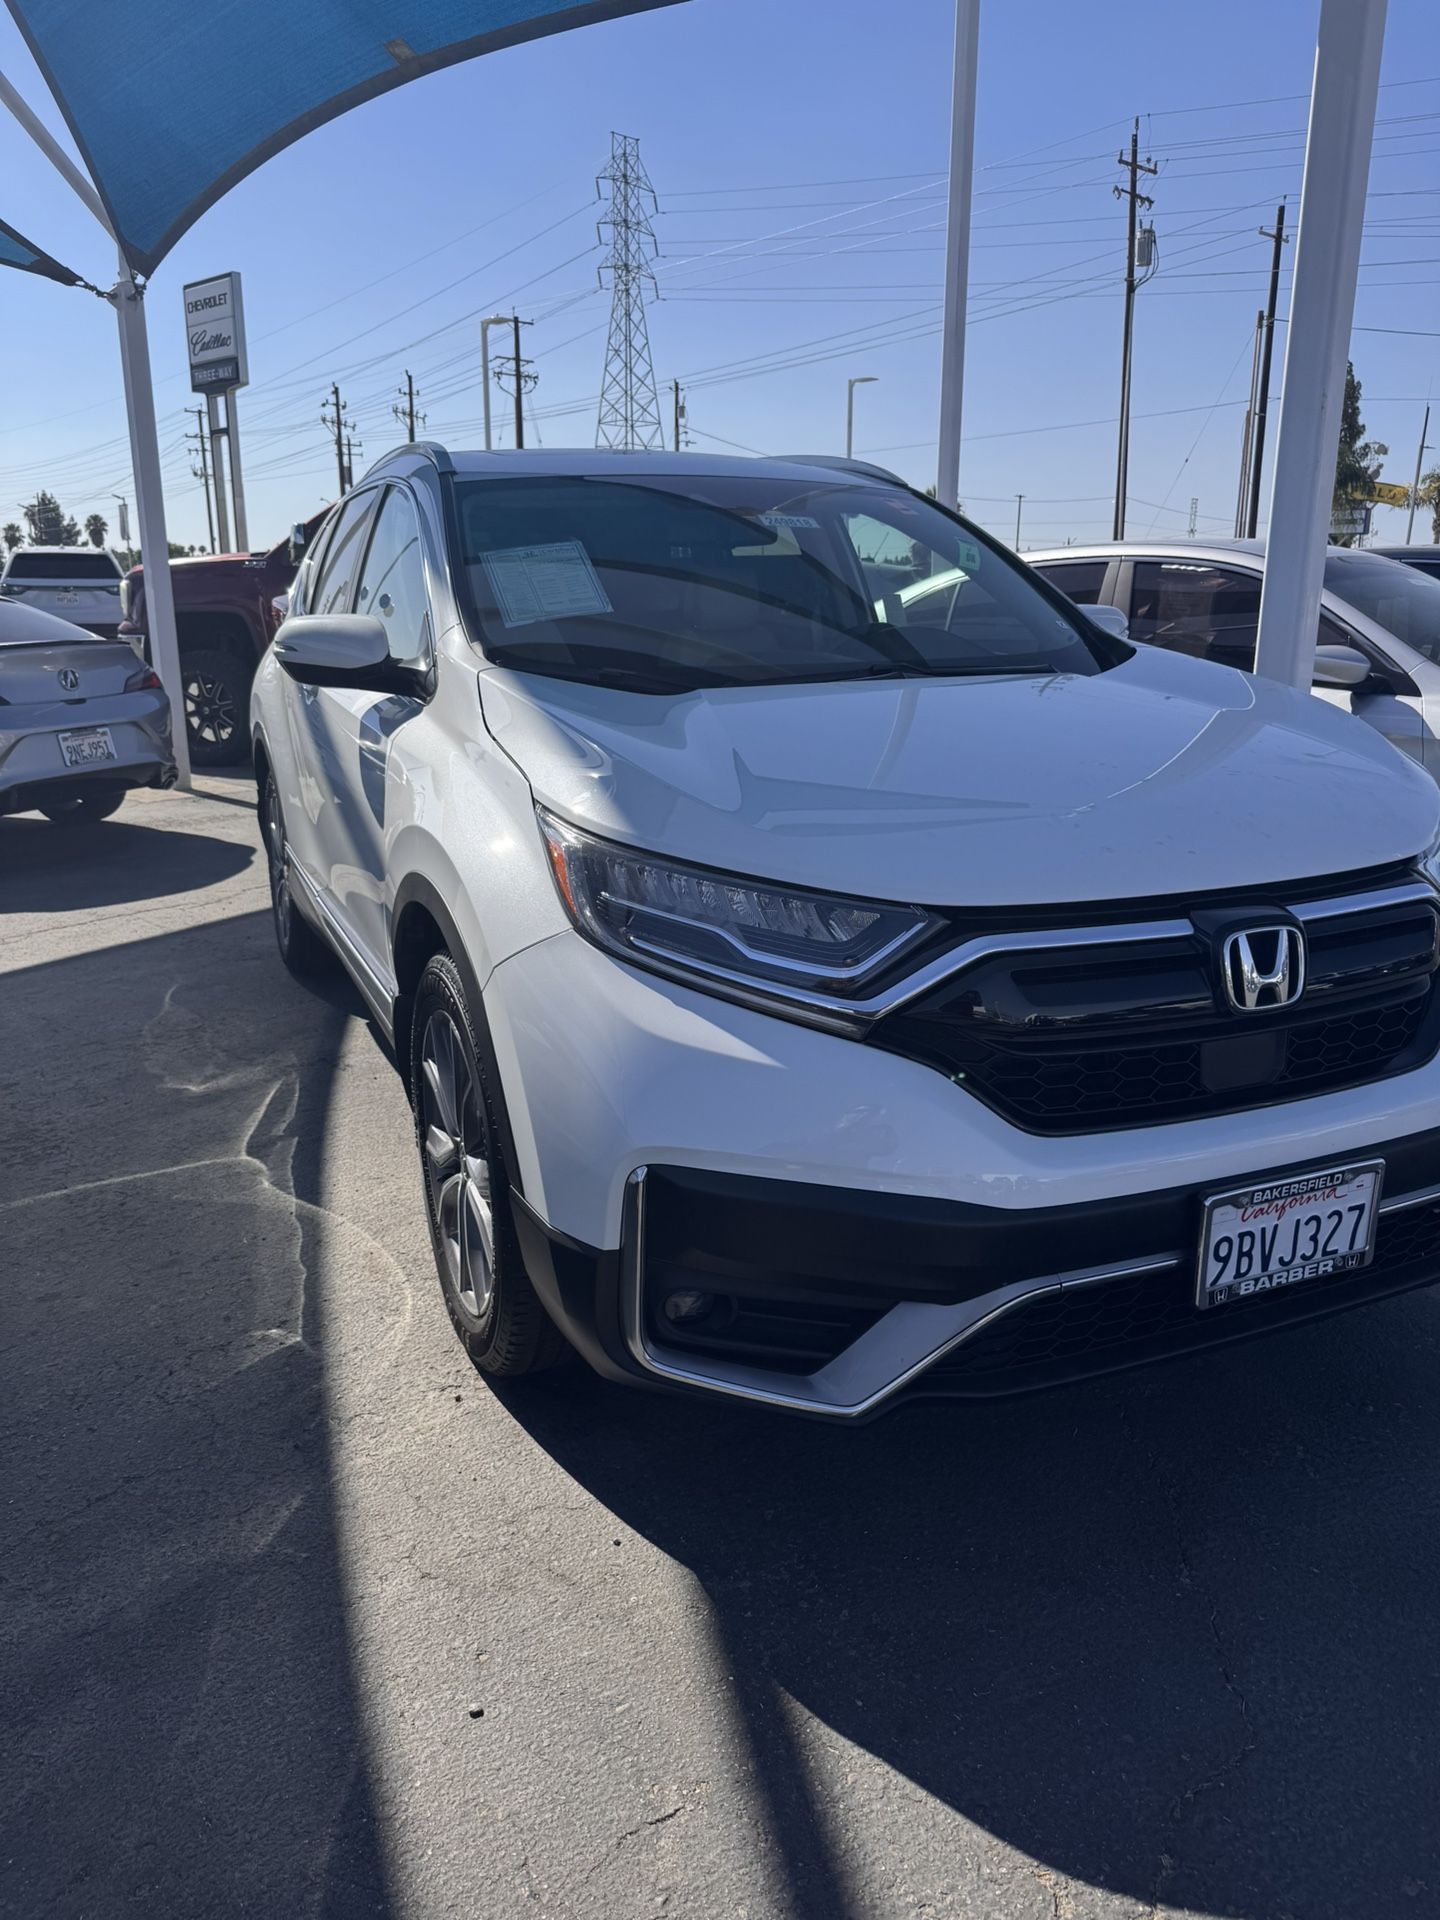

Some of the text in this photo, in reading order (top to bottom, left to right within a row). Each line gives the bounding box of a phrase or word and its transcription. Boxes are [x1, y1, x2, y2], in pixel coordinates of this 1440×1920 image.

[187, 293, 228, 314] CHEVROLET
[190, 329, 232, 357] Cadillac
[66, 740, 111, 764] 9NEJ951
[1252, 1173, 1343, 1204] BAKERSFIELD
[1241, 1187, 1348, 1222] California
[1210, 1203, 1366, 1287] 9BVJ327
[1239, 1259, 1334, 1295] BARBER
